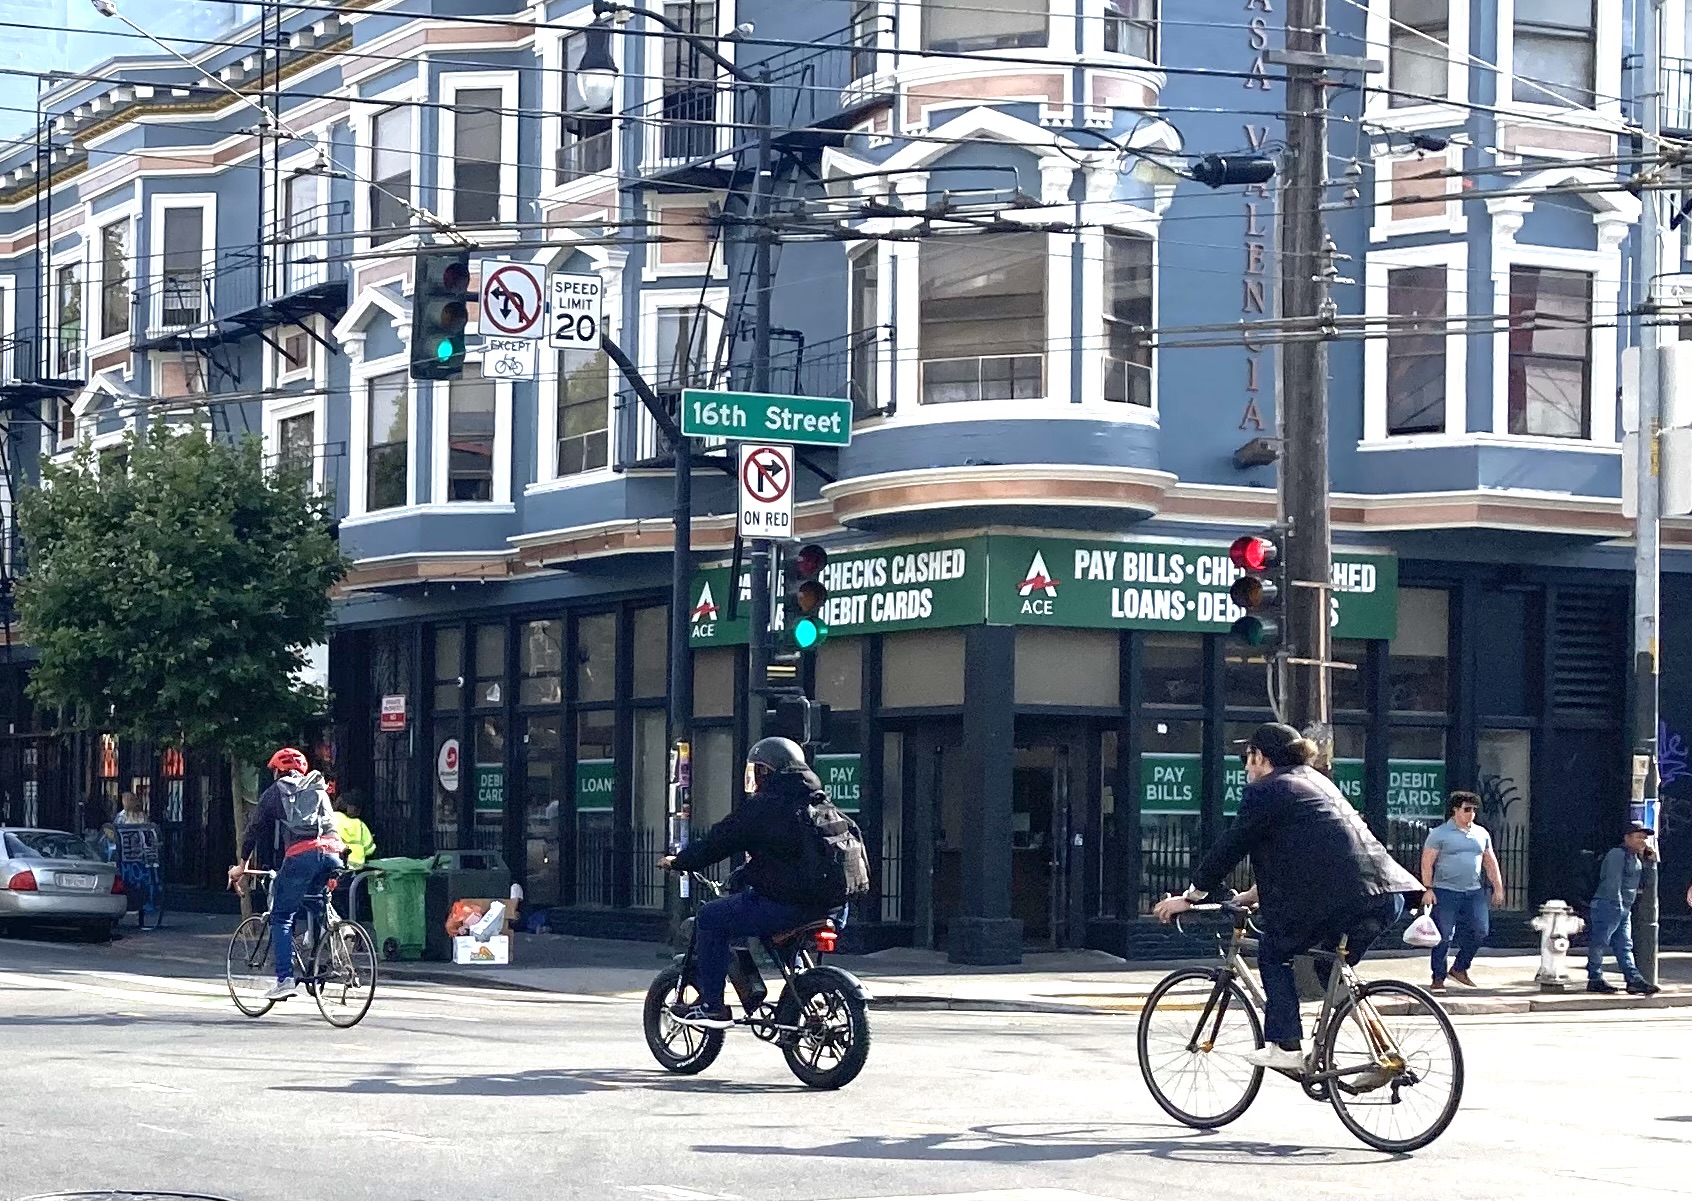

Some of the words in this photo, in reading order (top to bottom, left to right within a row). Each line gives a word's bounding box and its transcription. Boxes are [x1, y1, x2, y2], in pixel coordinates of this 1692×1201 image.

[554, 281, 599, 296] SPEED
[559, 297, 593, 311] LIMIT
[555, 313, 596, 342] 20
[490, 339, 531, 352] EXCEPT
[693, 402, 747, 427] 16th
[765, 406, 842, 434] Street
[744, 511, 761, 526] ON
[765, 511, 789, 527] RED
[891, 547, 966, 586] CASHED
[1074, 549, 1117, 581] PAY
[870, 587, 934, 623] CARDS
[1020, 600, 1053, 616] ACE
[691, 624, 715, 639] ACE
[480, 774, 503, 787] DEBI
[830, 767, 855, 782] PAY
[1154, 766, 1185, 783] PAY
[1389, 772, 1437, 788] DEBIT
[581, 778, 615, 792] LOAN
[824, 784, 860, 799] BILLS
[1146, 785, 1192, 801] BILLS
[1386, 789, 1441, 806] CARDS
